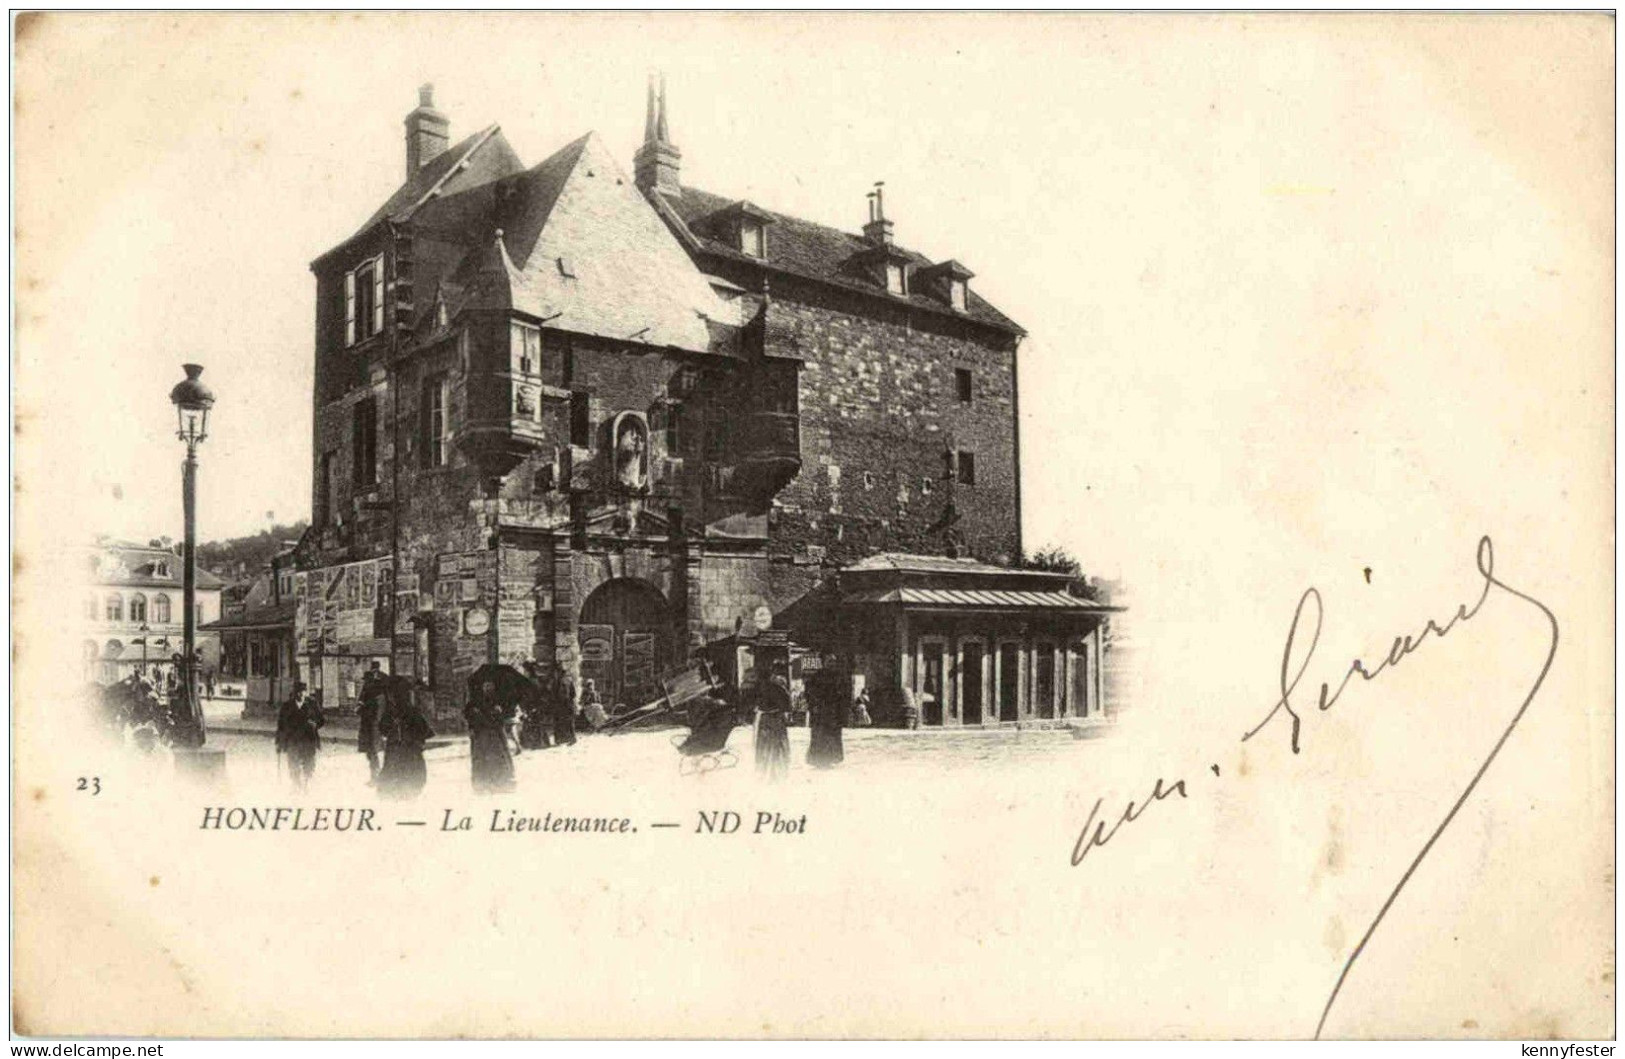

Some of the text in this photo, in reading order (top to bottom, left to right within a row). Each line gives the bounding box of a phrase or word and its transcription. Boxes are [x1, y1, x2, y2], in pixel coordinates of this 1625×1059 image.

[77, 777, 102, 795] 23
[200, 807, 382, 832] HONFLEUR.
[441, 808, 473, 832] La
[490, 809, 638, 833] Lieutenance.
[694, 811, 743, 833] ND
[753, 811, 807, 834] Phot
